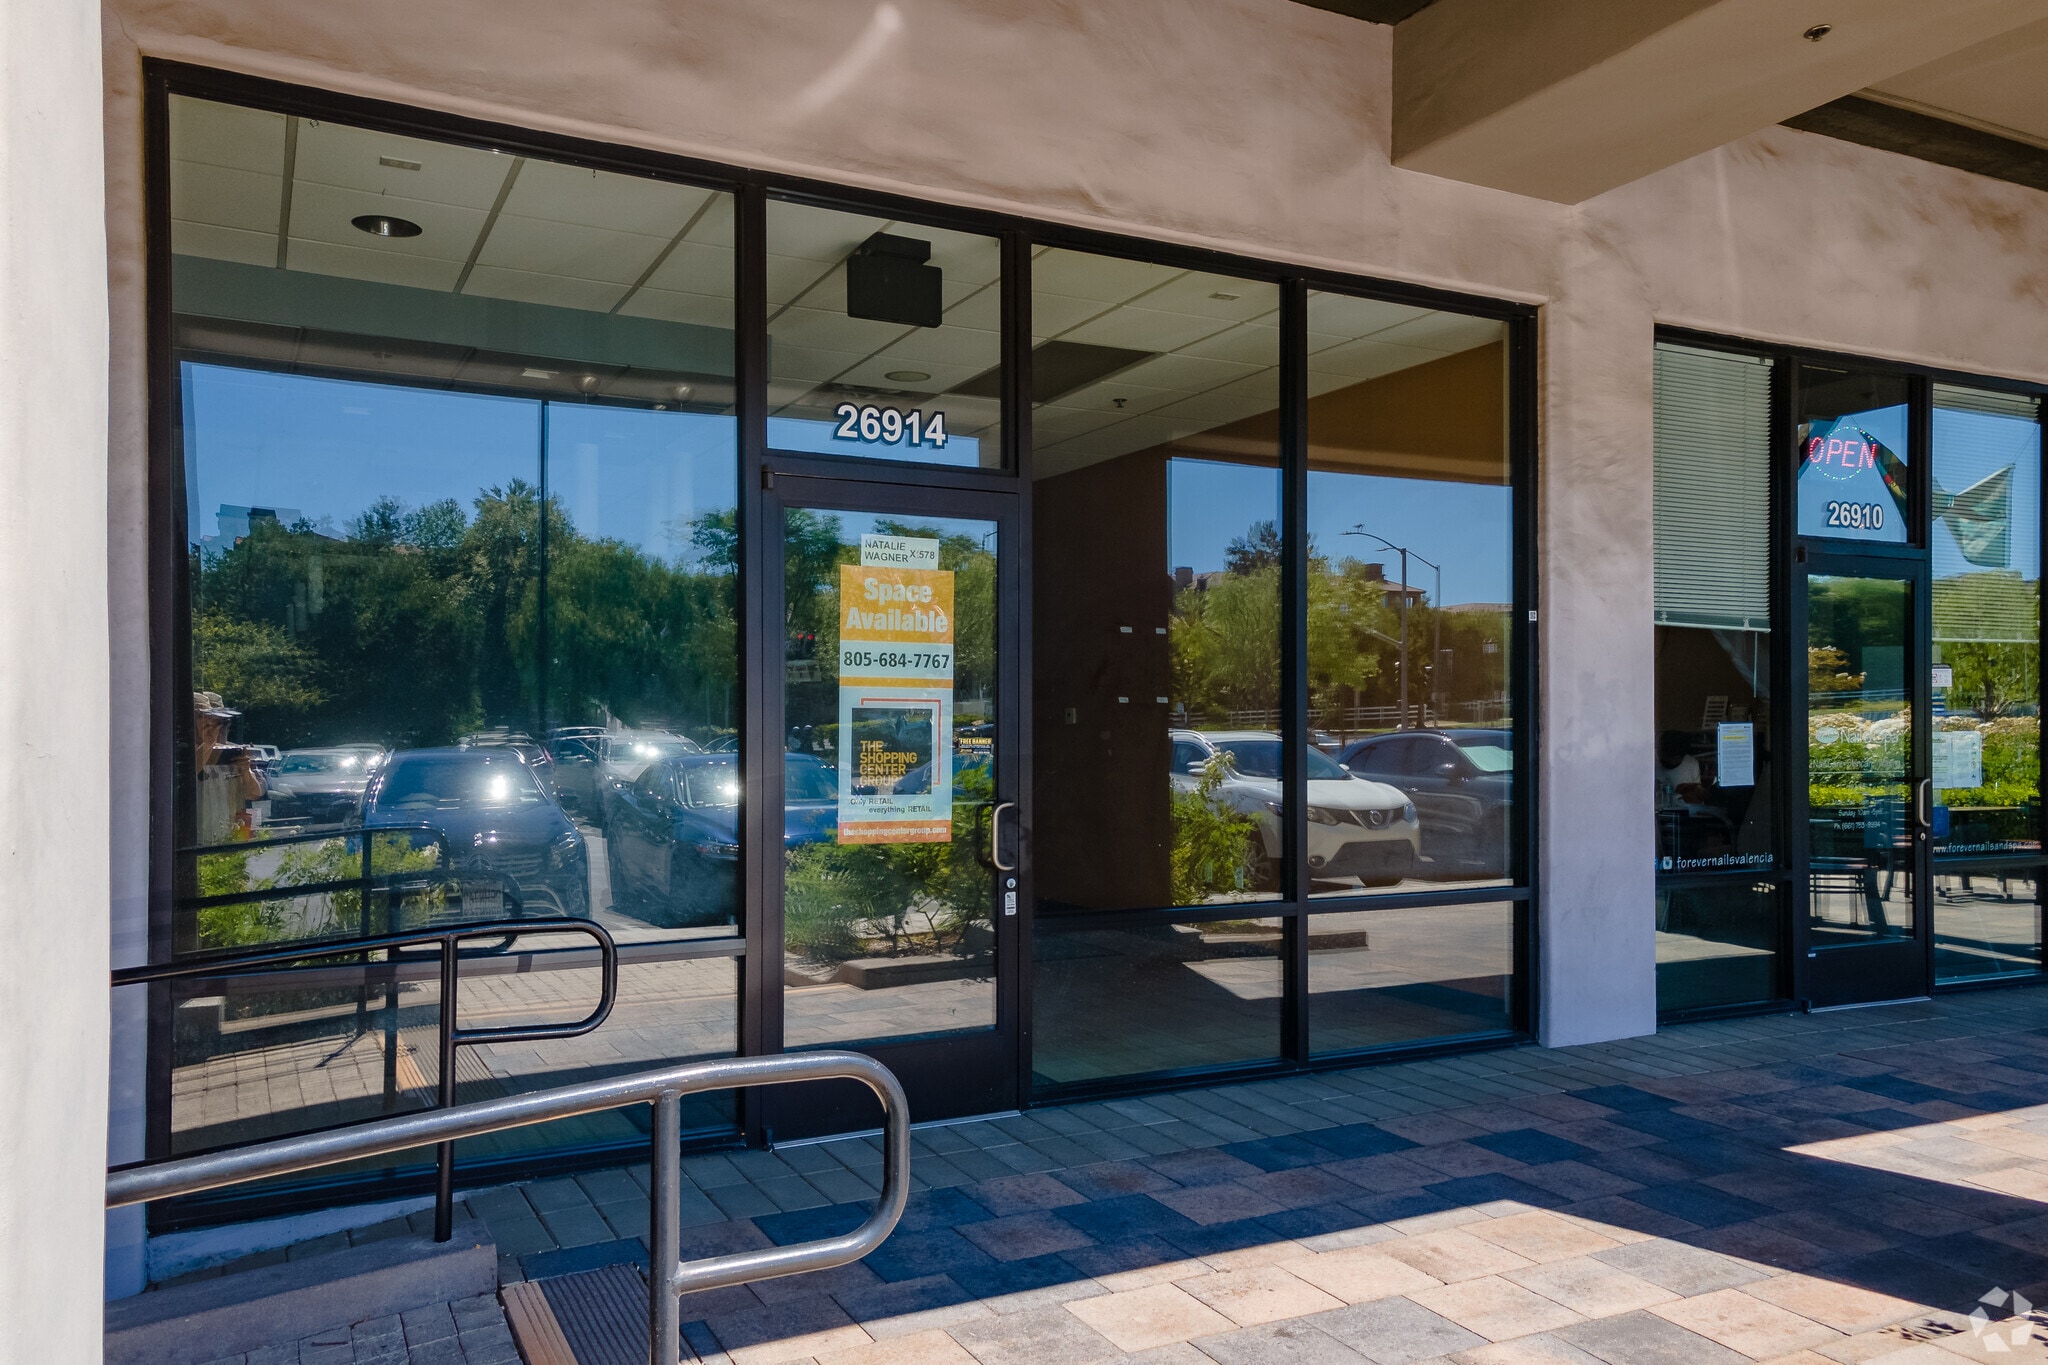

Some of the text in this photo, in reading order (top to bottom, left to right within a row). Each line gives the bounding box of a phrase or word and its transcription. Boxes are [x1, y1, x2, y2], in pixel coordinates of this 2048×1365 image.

[834, 402, 948, 448] 26914
[1808, 436, 1878, 469] OPEN
[1827, 501, 1883, 530] 26910
[864, 539, 906, 551] NATALIE
[864, 551, 909, 563] WAGNER
[864, 577, 933, 606] Space
[845, 607, 948, 633] Available
[843, 651, 950, 669] 805-684-7767
[860, 740, 884, 752] THE
[859, 752, 918, 764] SHOPPING
[859, 763, 907, 775] CENTER
[859, 774, 899, 786] GROUP
[868, 805, 932, 814] everything RETAIL
[843, 825, 947, 837] theshoppingcentergroup.com
[1676, 852, 1774, 869] forevernailsvalencia
